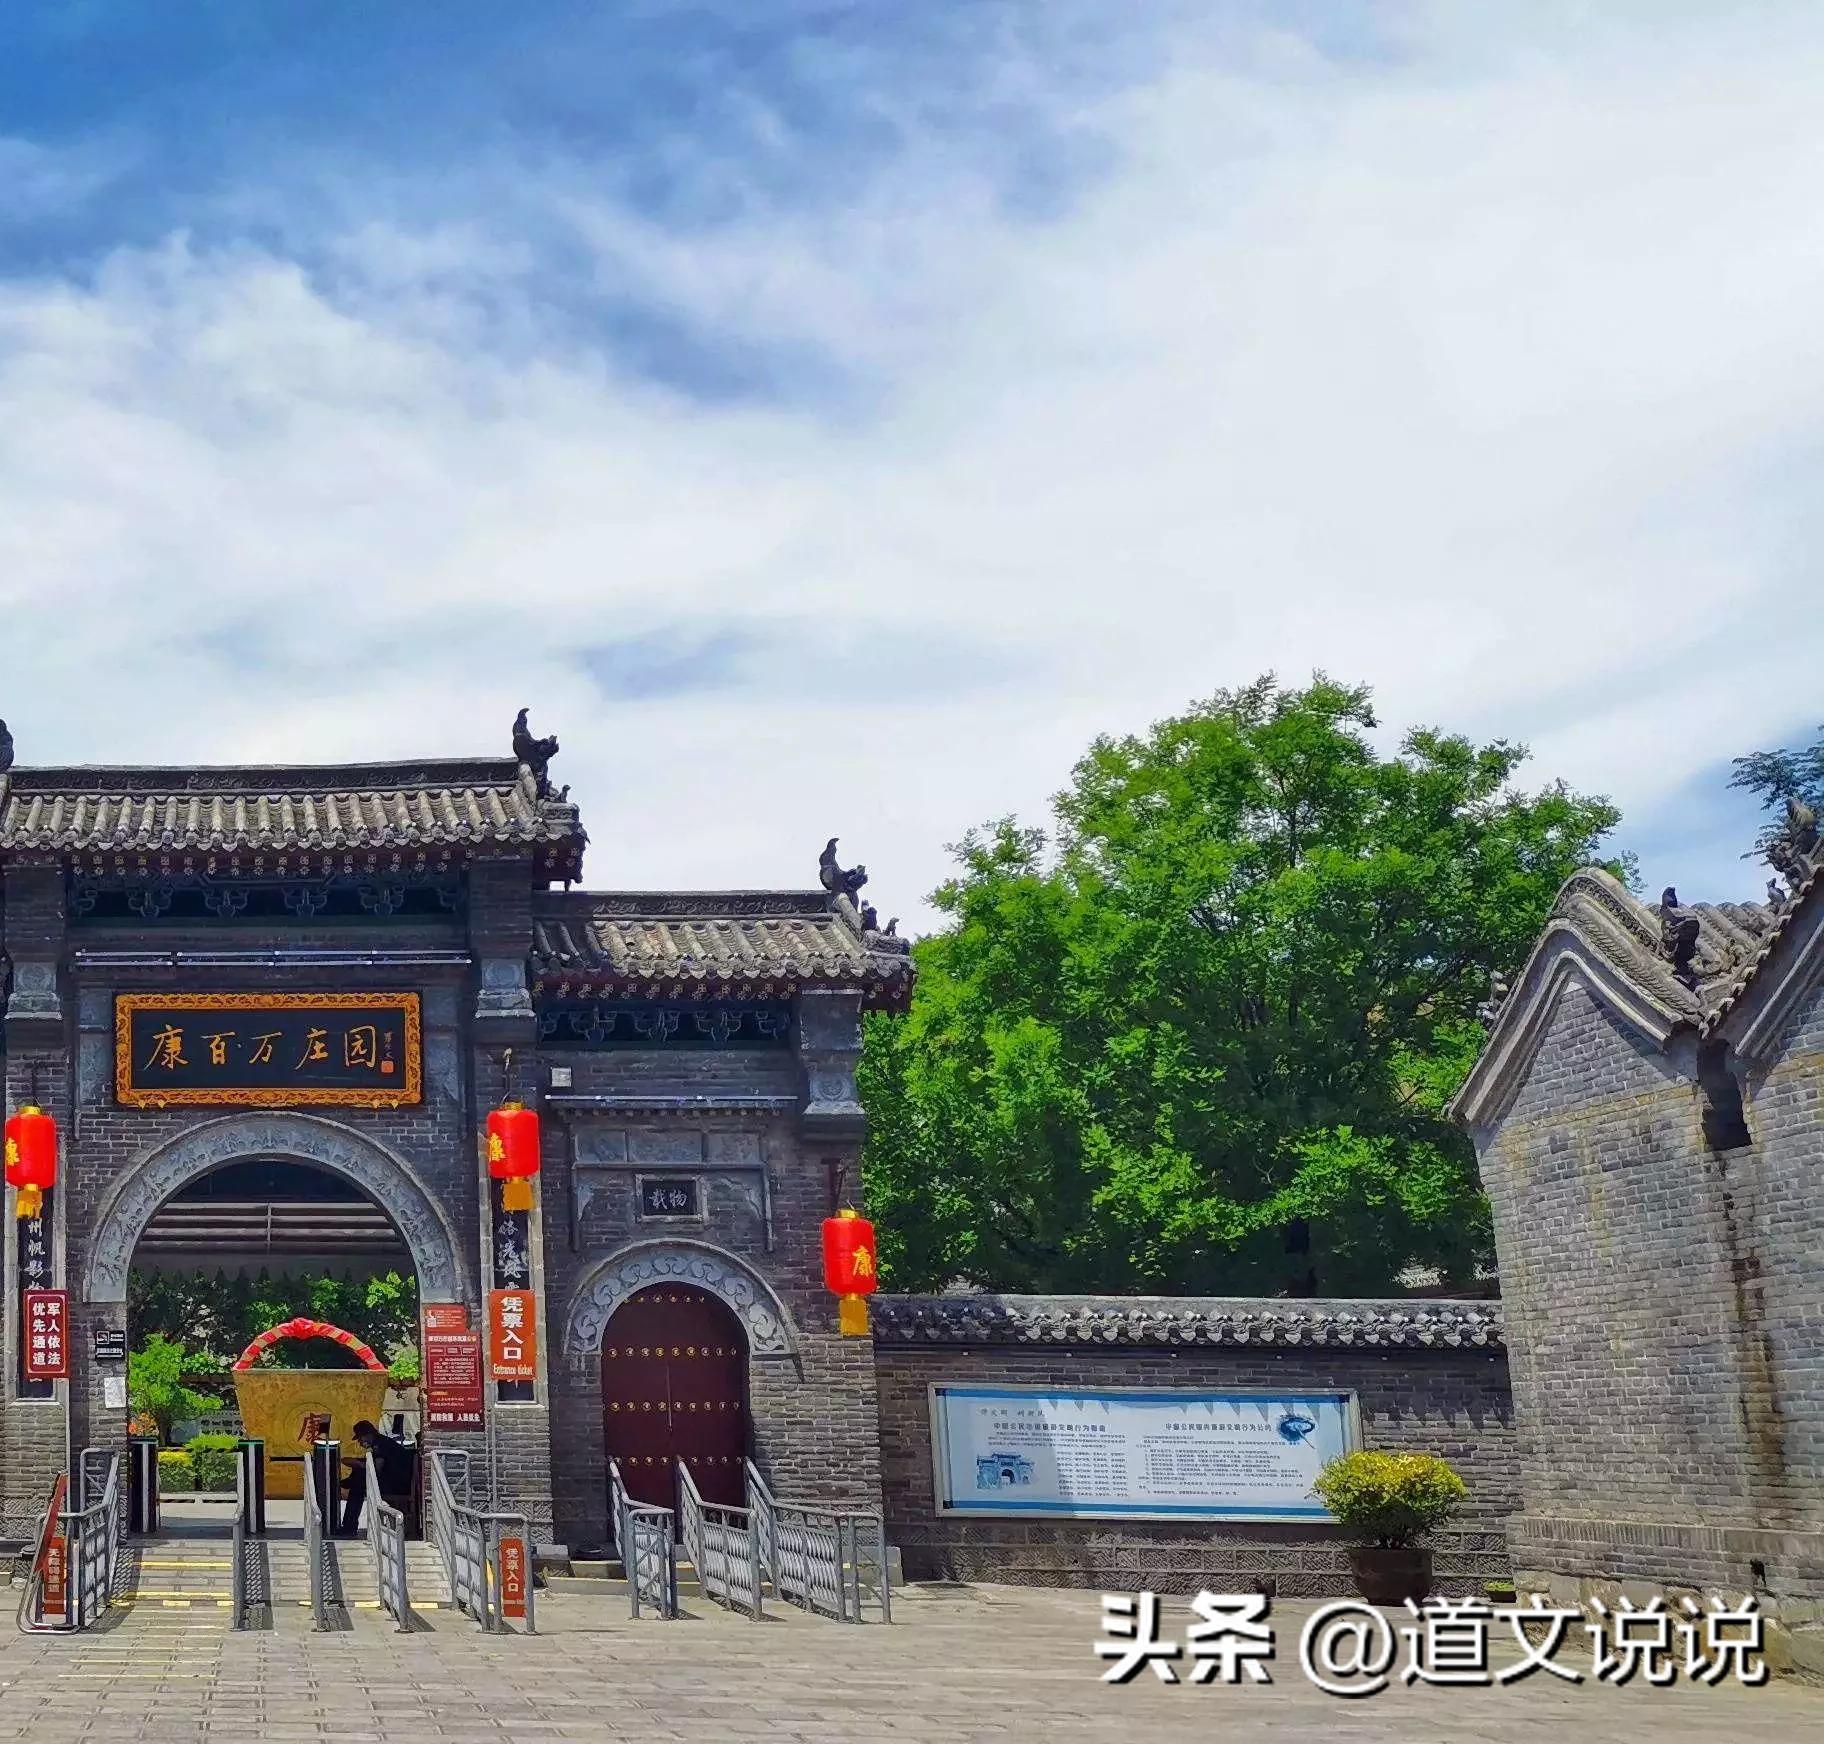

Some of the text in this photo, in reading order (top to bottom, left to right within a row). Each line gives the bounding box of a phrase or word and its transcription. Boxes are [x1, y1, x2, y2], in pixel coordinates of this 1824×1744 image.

[143, 1024, 376, 1071] 康百万庄园
[32, 1302, 46, 1366] 优先通道
[47, 1302, 61, 1366] 军人依法
[501, 1297, 524, 1360] 凭票入口
